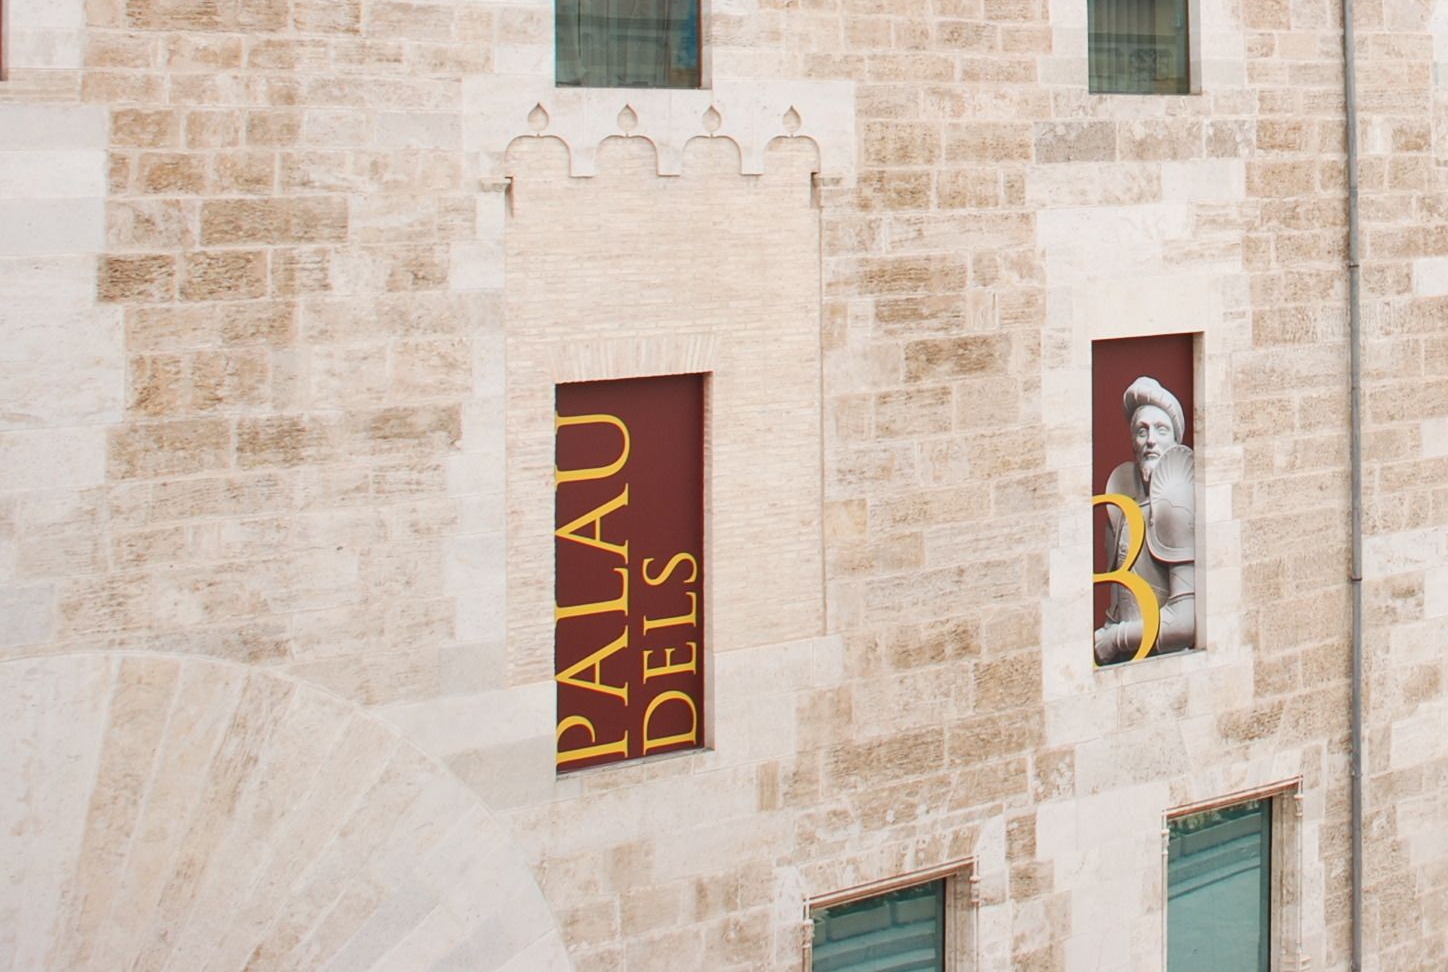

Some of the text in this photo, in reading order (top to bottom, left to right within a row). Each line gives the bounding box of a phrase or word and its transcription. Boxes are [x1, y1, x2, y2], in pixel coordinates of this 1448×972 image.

[554, 410, 631, 766] PALAU
[642, 552, 698, 756] DELS
[1092, 493, 1160, 669] B
